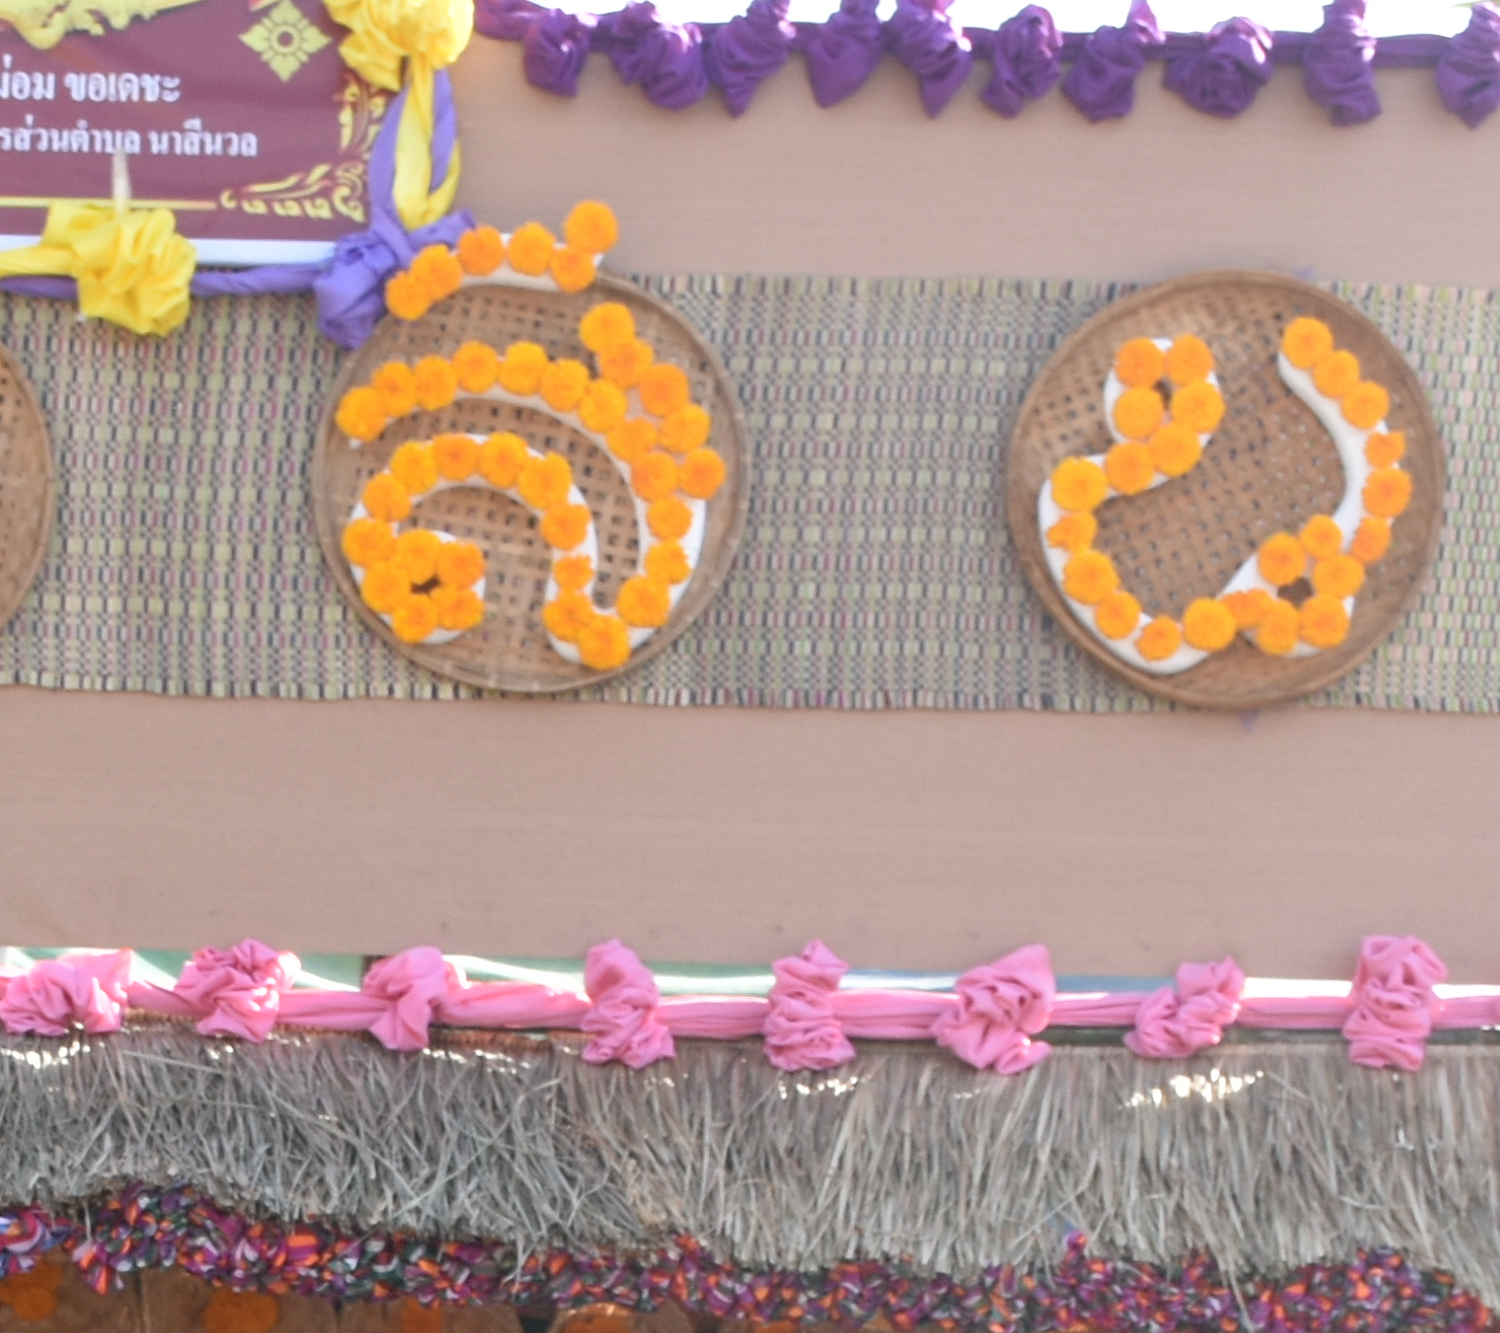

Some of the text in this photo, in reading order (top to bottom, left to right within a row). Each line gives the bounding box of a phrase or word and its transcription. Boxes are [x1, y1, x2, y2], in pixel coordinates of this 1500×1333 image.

[63, 71, 181, 103] ขอเดชะ
[148, 117, 258, 157] นาสีนวล
